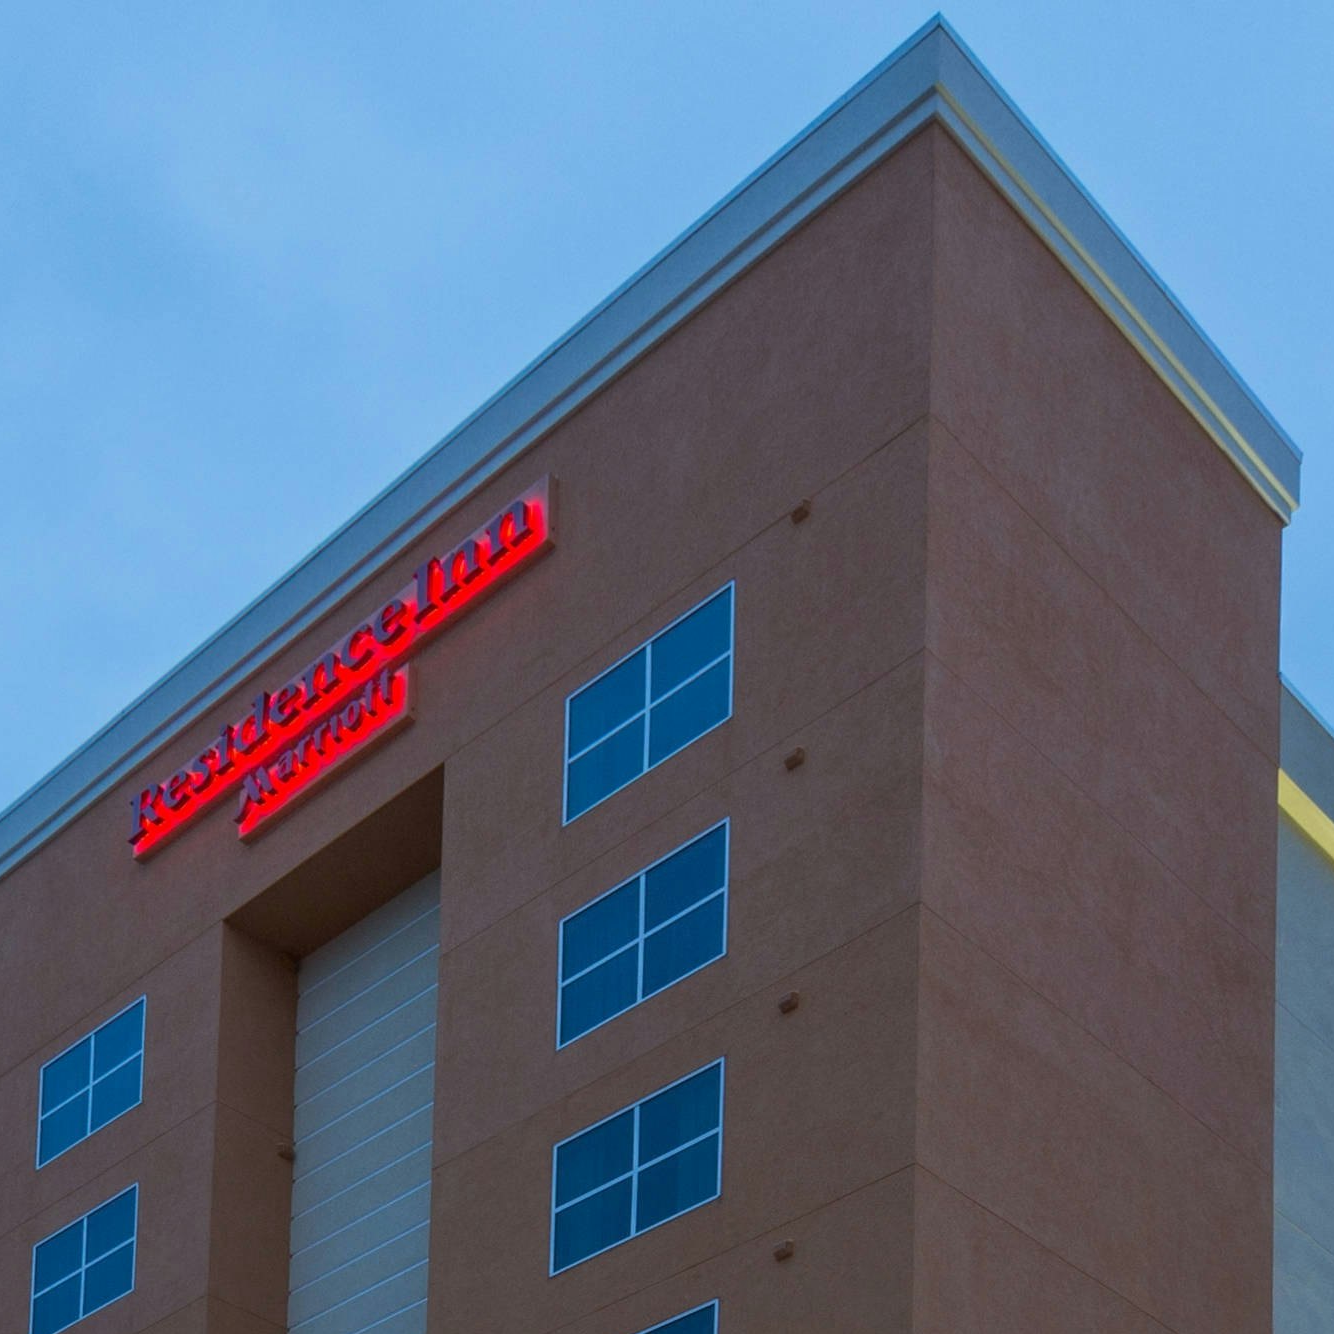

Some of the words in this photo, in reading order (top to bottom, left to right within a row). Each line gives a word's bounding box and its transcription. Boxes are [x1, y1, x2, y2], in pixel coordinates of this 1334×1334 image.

[128, 597, 409, 845] Residence
[413, 499, 535, 625] Inn
[233, 667, 397, 823] Marriott
